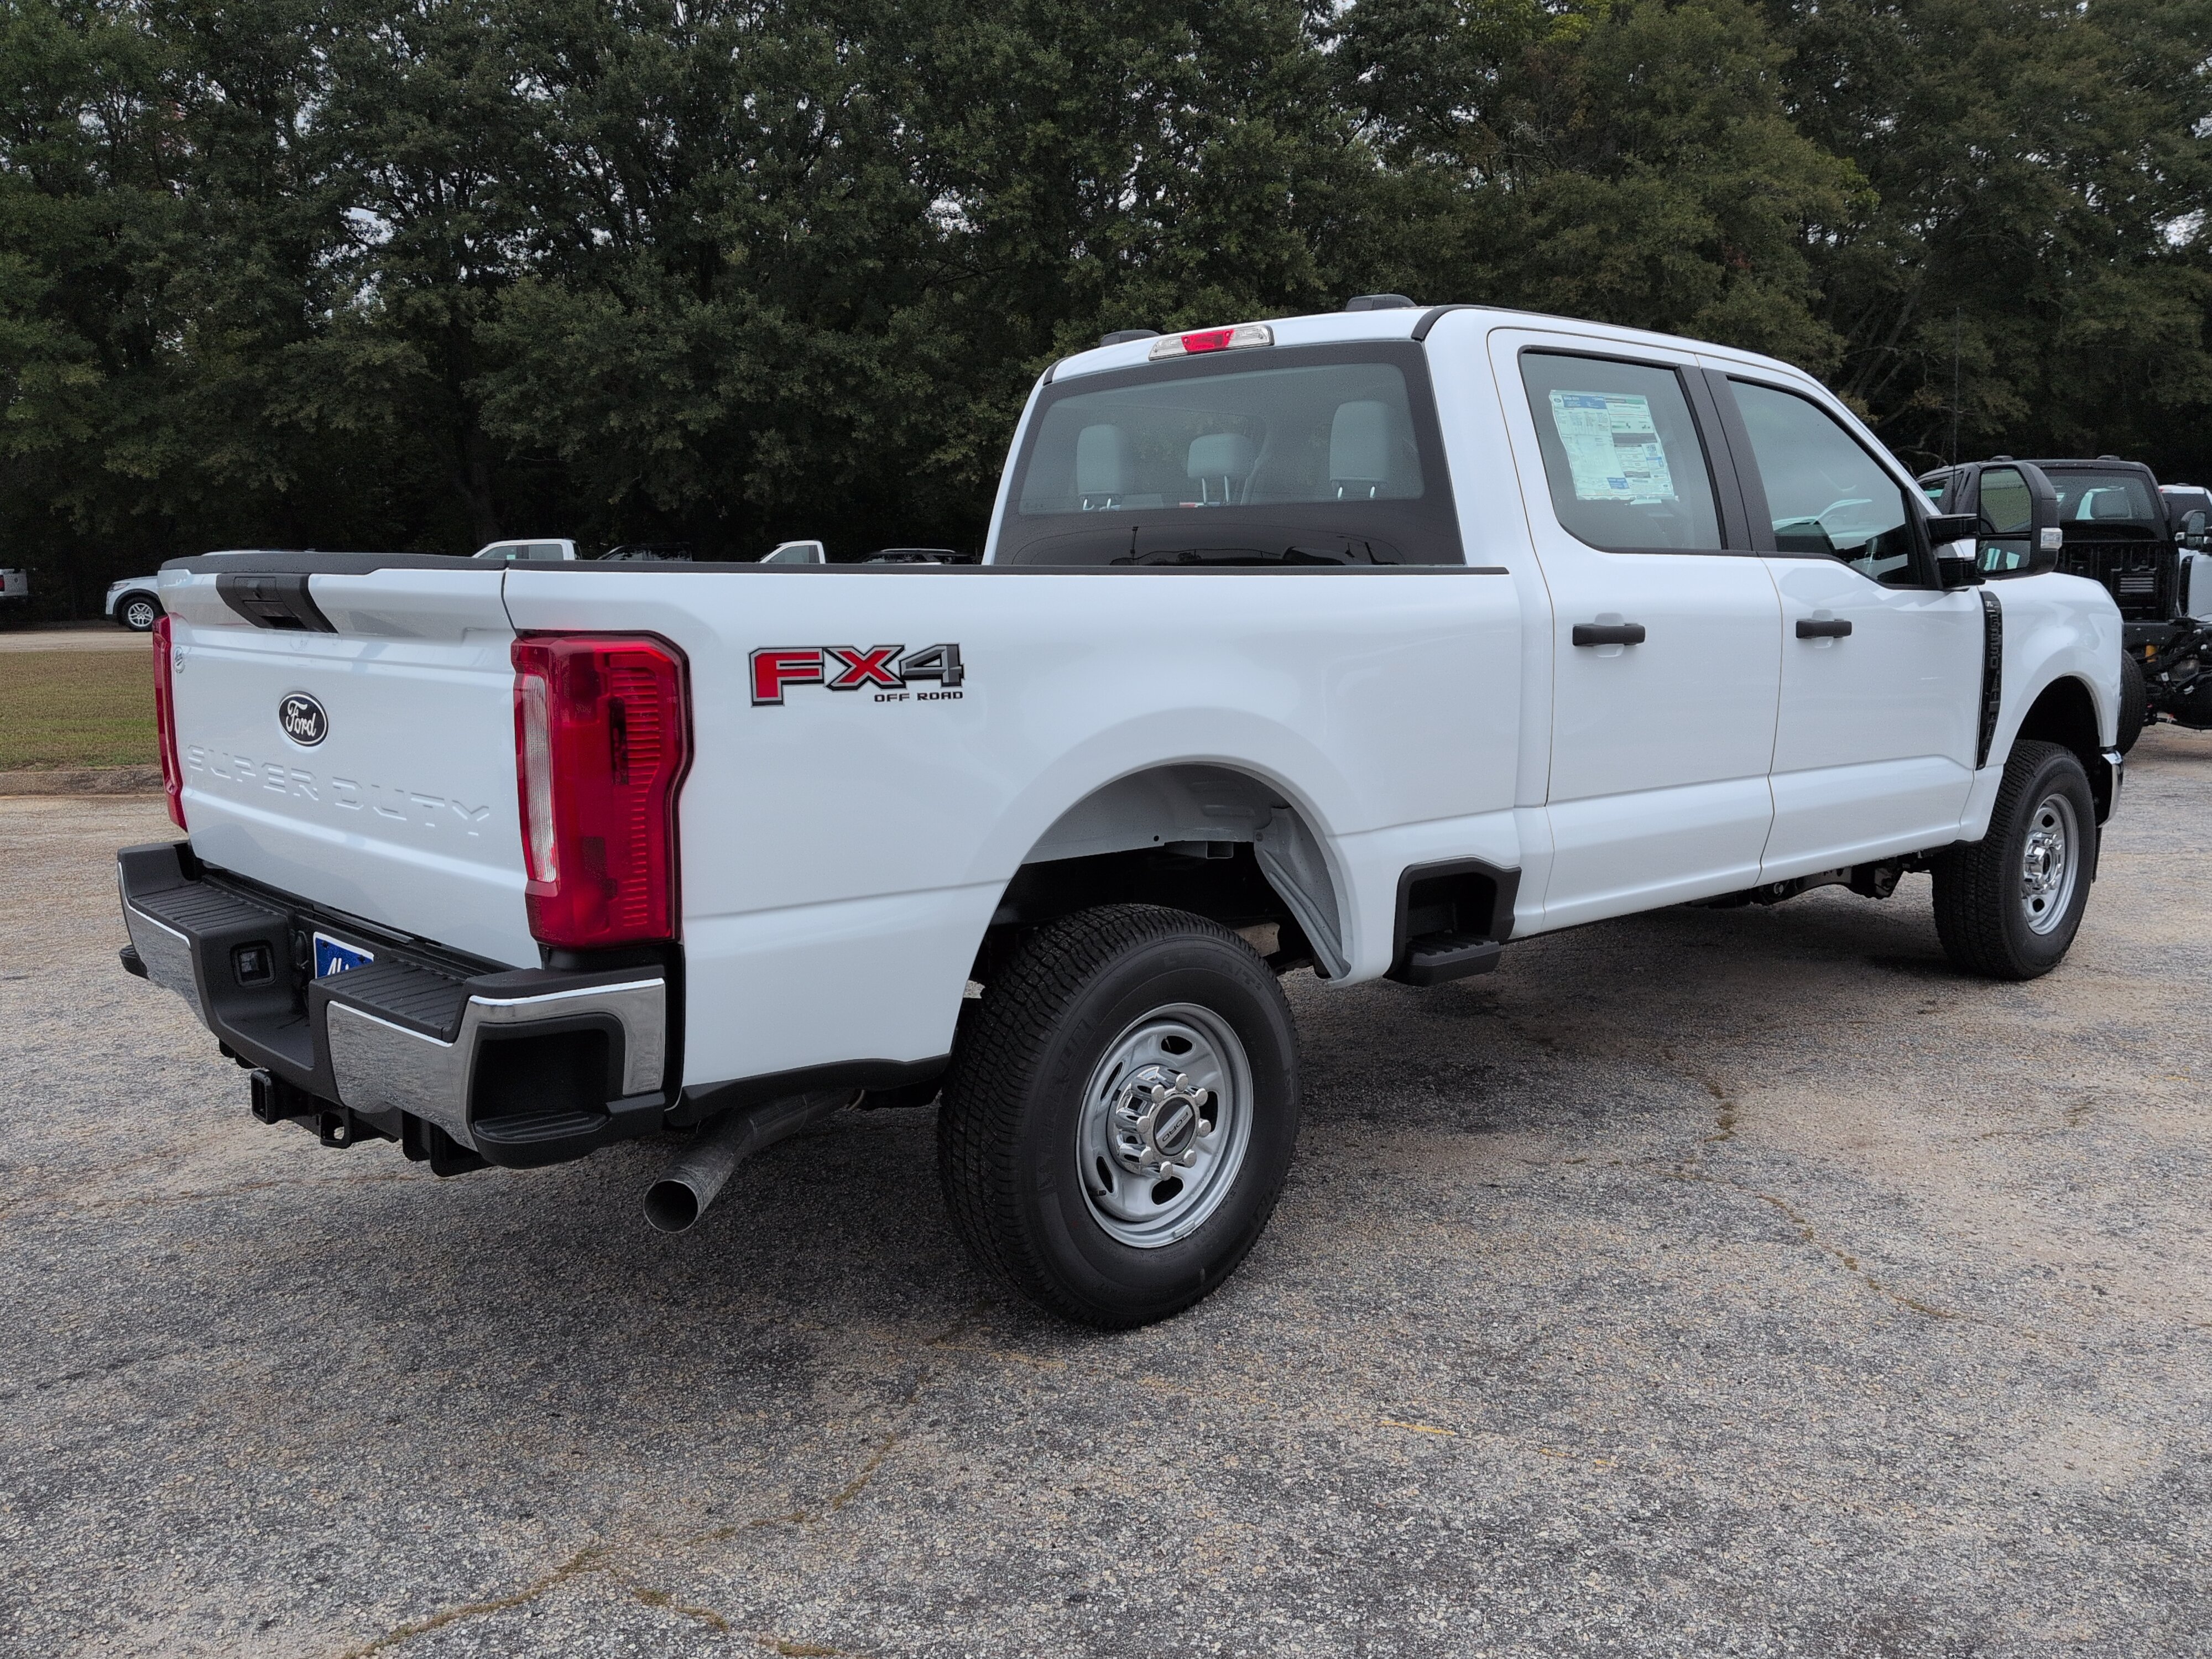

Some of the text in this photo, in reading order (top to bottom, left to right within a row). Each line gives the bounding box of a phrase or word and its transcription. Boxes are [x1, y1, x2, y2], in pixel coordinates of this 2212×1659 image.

[748, 643, 966, 708] FX4
[874, 691, 963, 702] OFF ROAD
[285, 700, 316, 737] Ford
[188, 745, 489, 836] SUPER DUTY
[1162, 1112, 1188, 1142] FORD
